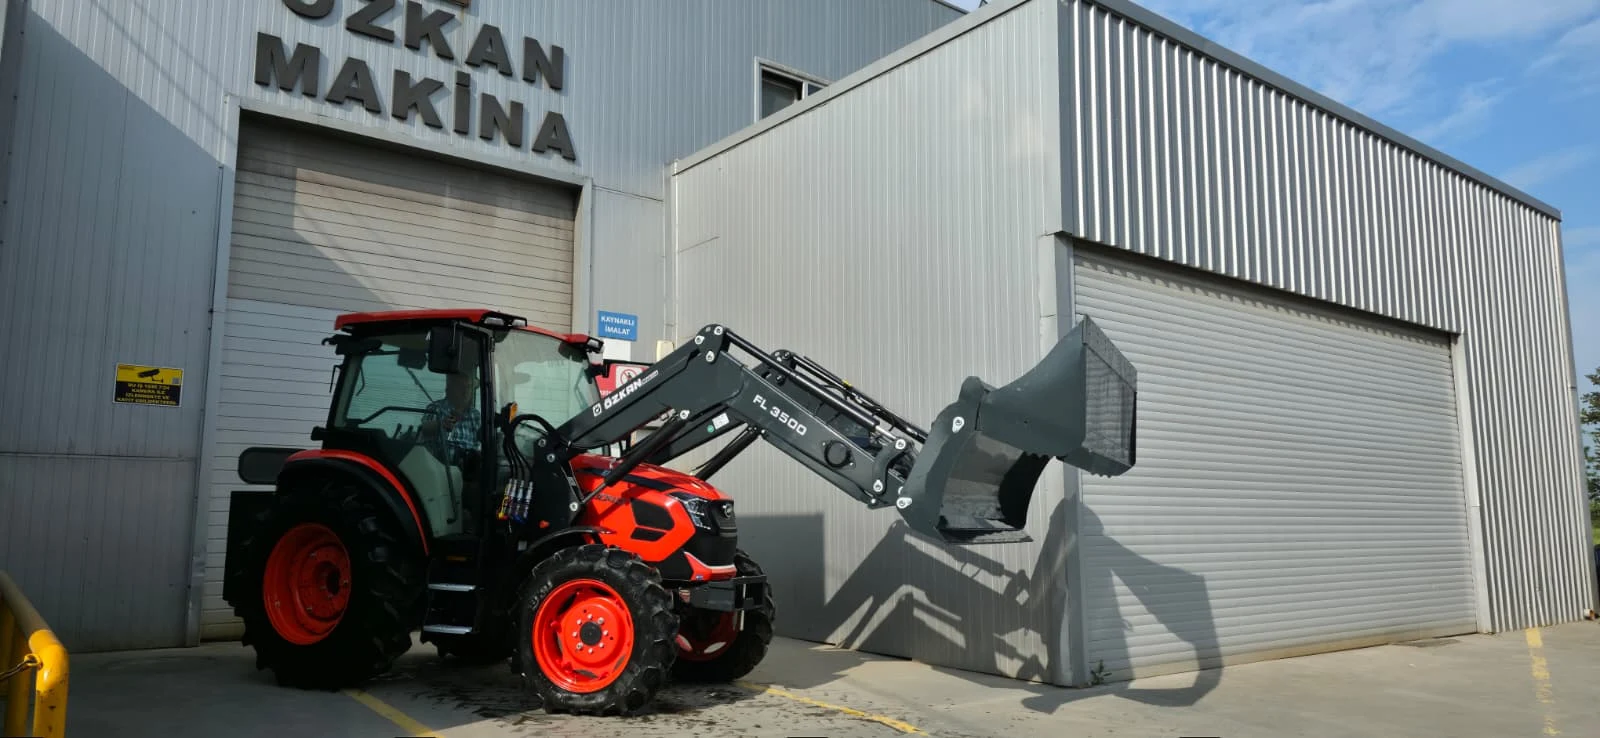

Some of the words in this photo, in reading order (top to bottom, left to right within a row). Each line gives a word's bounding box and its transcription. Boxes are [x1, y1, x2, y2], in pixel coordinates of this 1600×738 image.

[254, 32, 576, 161] MAKİNA
[600, 315, 635, 327] KAYNAKLI
[605, 324, 631, 336] İMALAT
[604, 378, 643, 410] ÖZKAN
[752, 394, 768, 411] FL
[769, 406, 808, 436] 3500
